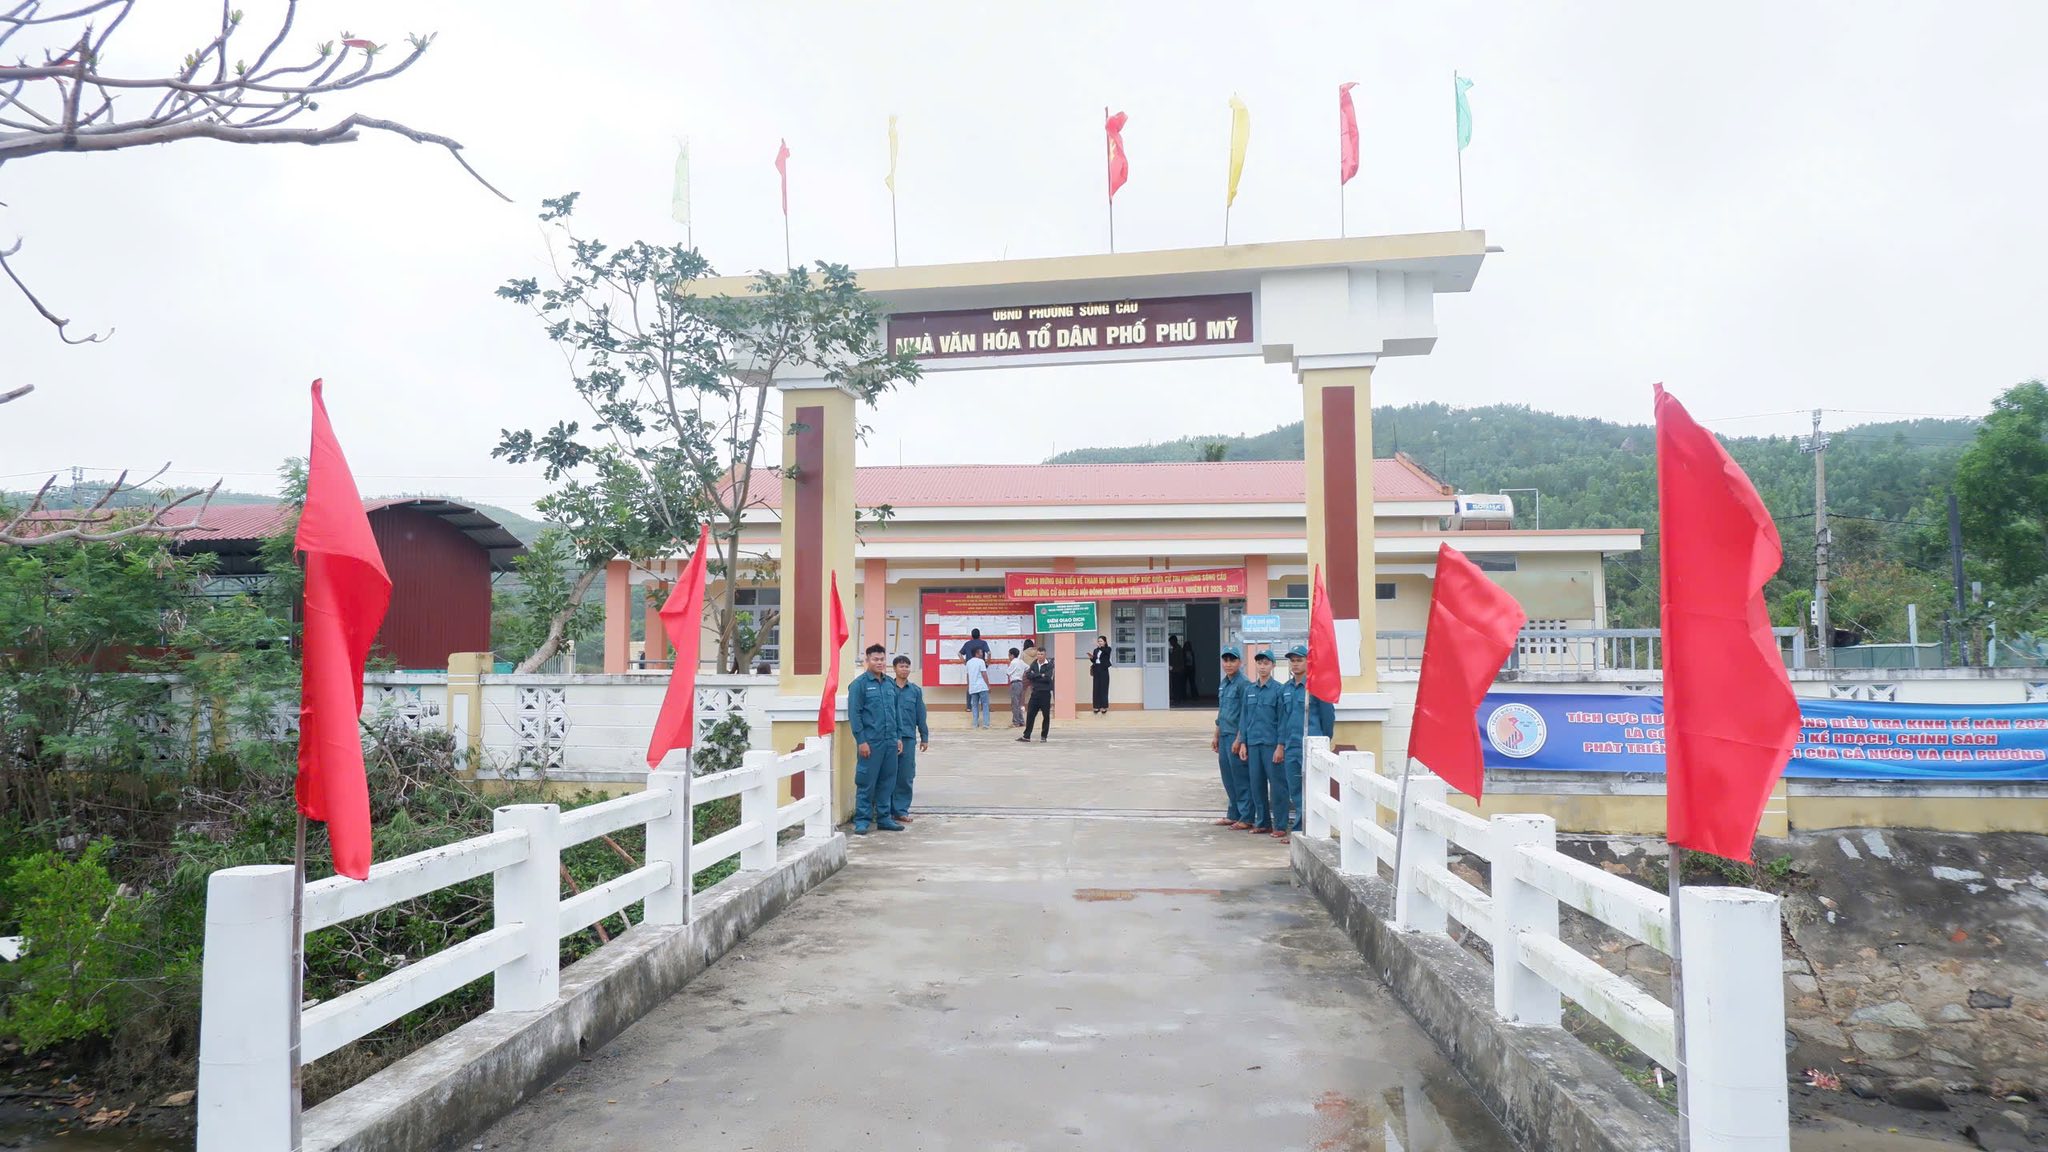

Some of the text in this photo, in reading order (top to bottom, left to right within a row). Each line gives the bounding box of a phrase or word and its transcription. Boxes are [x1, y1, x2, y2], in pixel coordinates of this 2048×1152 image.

[993, 308, 1023, 321] UBND
[895, 316, 1239, 356] NHÀ VĂN HÓA TỔ DÂN PHỐ PHÚ MỸ
[1566, 711, 1603, 724] TÍCH
[1606, 711, 1639, 726] CỰC
[1830, 716, 1868, 729] ĐIỀU
[1871, 718, 1904, 730] TRA
[1905, 719, 1947, 730] KINH
[1950, 716, 1971, 730] TẾ
[1973, 718, 2011, 730] NĂM
[1624, 726, 1645, 739] LÀ
[1808, 730, 1830, 744] KẾ
[1832, 733, 1893, 746] HOẠCH,
[1895, 731, 1949, 745] CHÍNH
[1951, 732, 1998, 745] SÁCH
[1583, 742, 1623, 753] PHÁT
[1805, 747, 1839, 759] CỦA
[1841, 746, 1865, 759] CẢ
[1867, 748, 1914, 759] NƯỚC
[1916, 748, 1940, 760] VÀ
[1942, 749, 1973, 762] ĐỊA
[1975, 749, 2046, 761] PHƯƠNG
